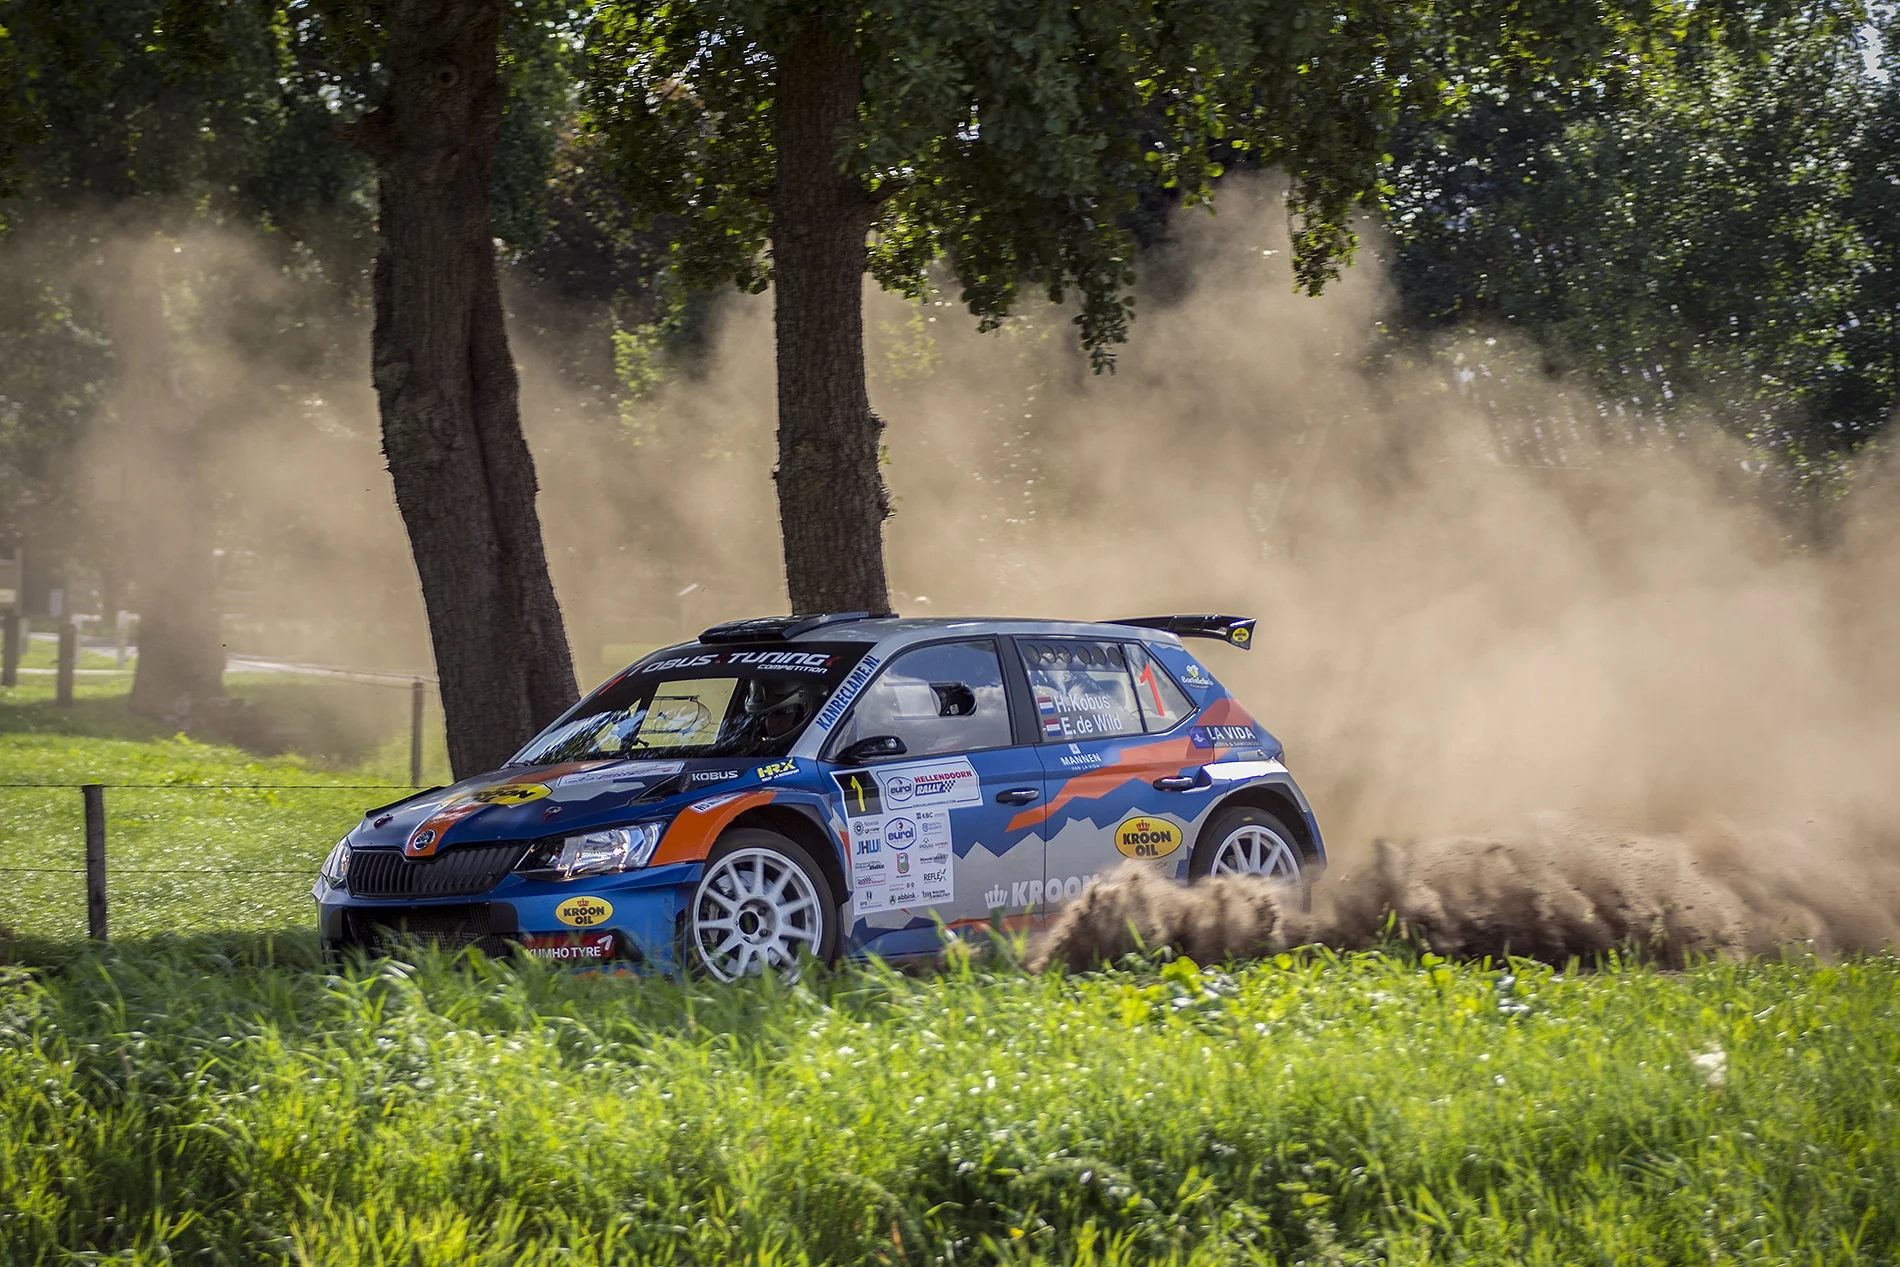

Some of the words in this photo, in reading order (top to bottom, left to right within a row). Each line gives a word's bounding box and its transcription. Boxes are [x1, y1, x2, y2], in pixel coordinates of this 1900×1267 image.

[727, 651, 831, 667] TUNING
[757, 664, 829, 675] COMPETITION
[815, 654, 881, 731] KANRECLAME.NL
[1139, 663, 1166, 717] 1
[1076, 715, 1094, 734] de
[1093, 713, 1124, 732] Wild
[1206, 726, 1225, 740] LA
[1223, 726, 1257, 740] VIDA
[1060, 752, 1102, 766] MANNEN
[757, 758, 797, 778] HRX
[692, 770, 739, 781] KOBUS
[914, 770, 973, 784] HELLENDOORN
[850, 775, 866, 812] 1
[890, 783, 912, 794] eurol
[916, 783, 942, 795] RALLY
[887, 827, 914, 841] eurol
[1122, 831, 1172, 845] KROON
[1134, 845, 1158, 857] OIL
[563, 906, 605, 917] KROON
[574, 916, 594, 925] OIL
[570, 946, 601, 958] TYRE
